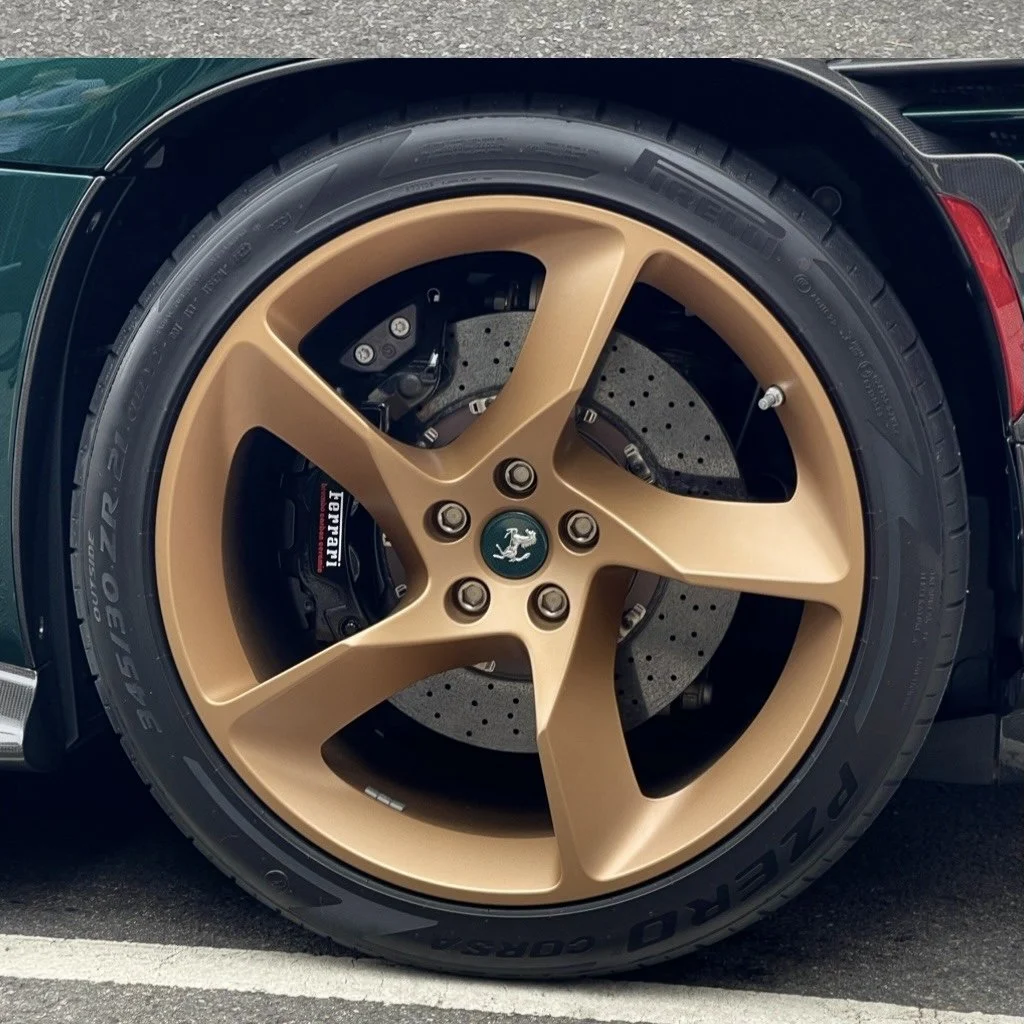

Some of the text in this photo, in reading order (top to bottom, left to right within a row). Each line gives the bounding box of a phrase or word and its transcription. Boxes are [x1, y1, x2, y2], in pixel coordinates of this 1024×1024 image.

[325, 490, 344, 567] Ferrari
[87, 531, 102, 623] OUTSIDE
[431, 933, 595, 959] CORSA
